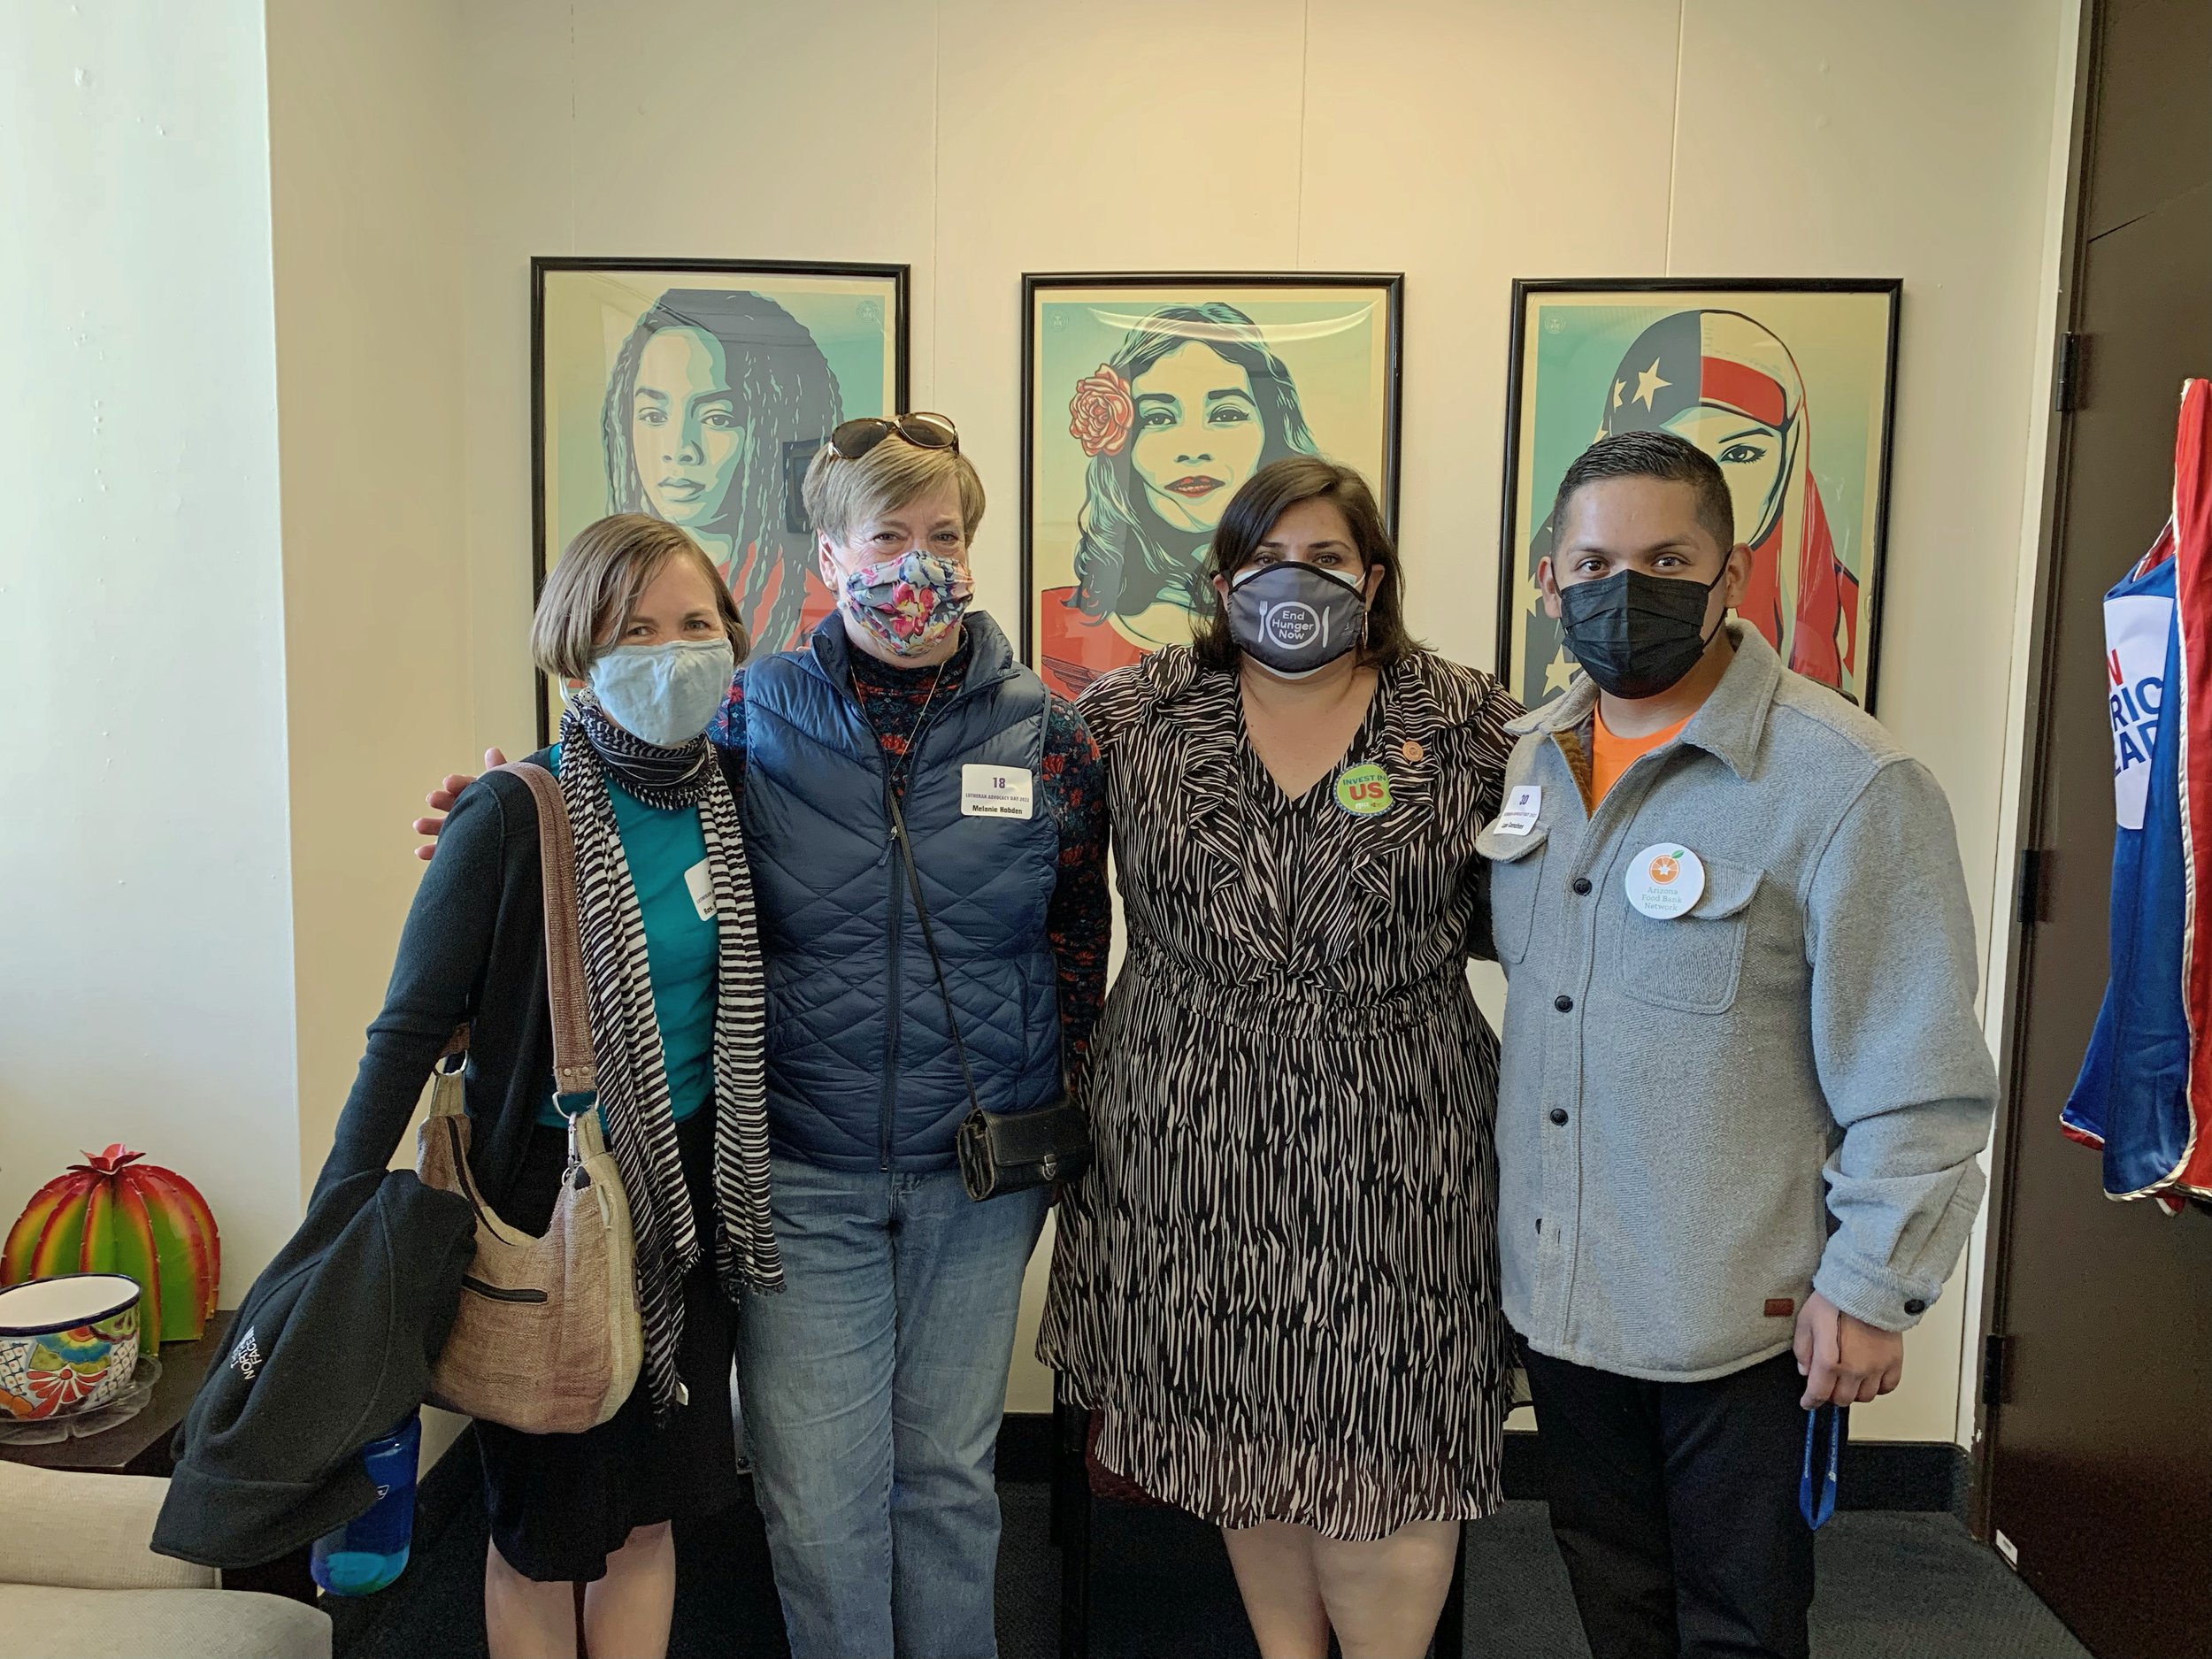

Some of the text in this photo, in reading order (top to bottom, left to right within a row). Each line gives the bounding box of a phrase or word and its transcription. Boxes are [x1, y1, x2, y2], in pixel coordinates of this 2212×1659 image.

[1282, 611, 1305, 621] End
[1271, 619, 1315, 634] Hunger
[1279, 629, 1305, 640] Now
[993, 777, 1006, 788] 18
[1342, 775, 1376, 786] INVEST
[1348, 781, 1385, 801] US
[972, 804, 998, 813] Melanie
[1644, 902, 1678, 911] Network
[246, 1336, 263, 1365] FACE
